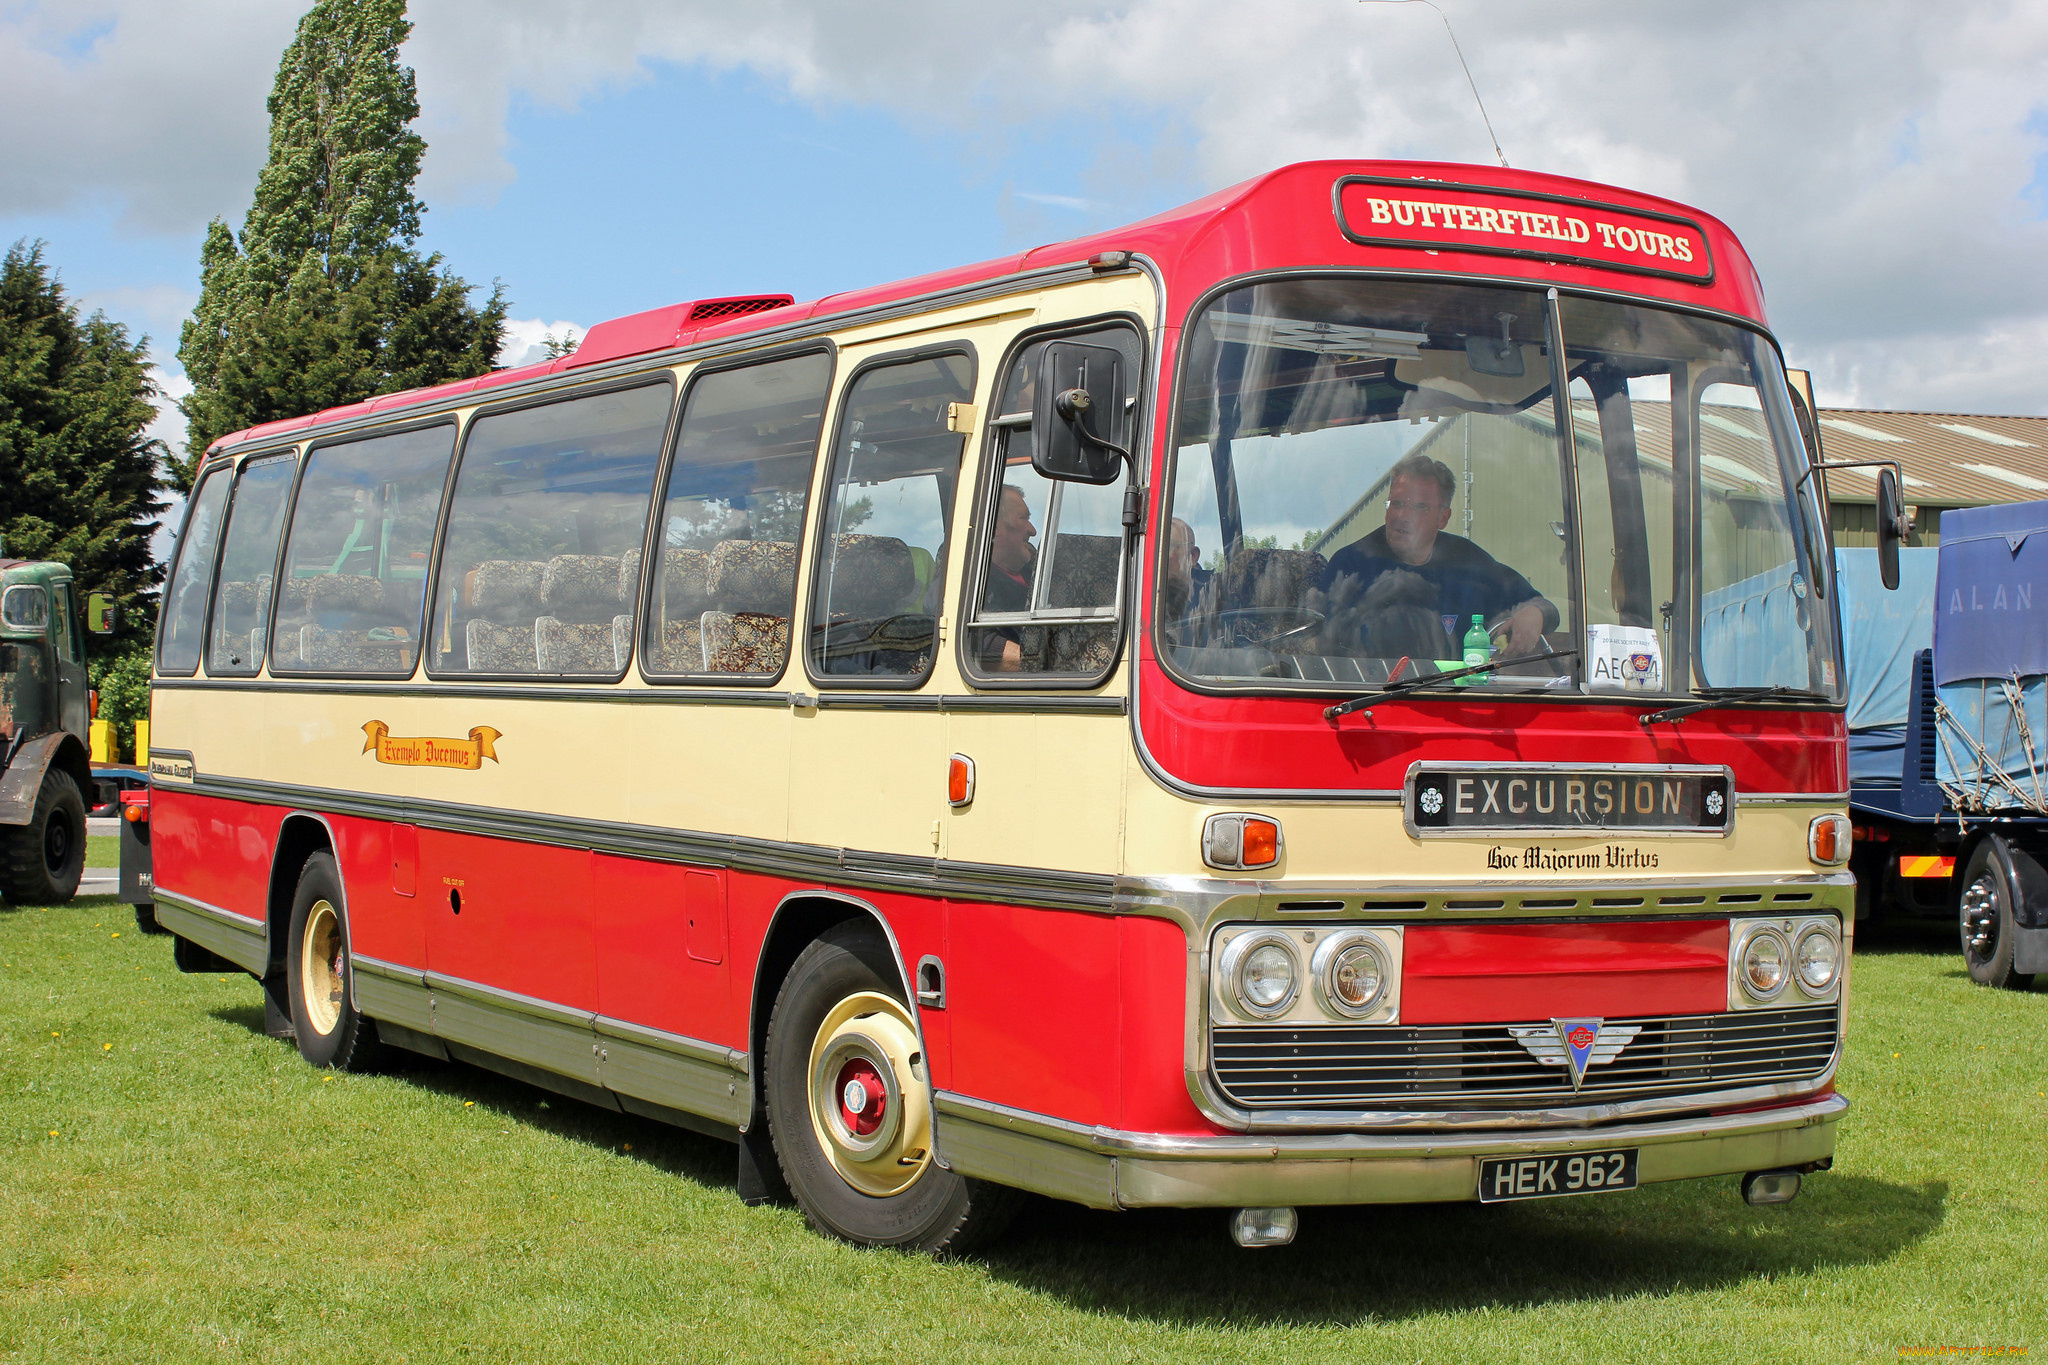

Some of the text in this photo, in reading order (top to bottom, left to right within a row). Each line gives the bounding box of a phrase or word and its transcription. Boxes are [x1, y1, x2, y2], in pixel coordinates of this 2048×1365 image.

[1366, 197, 1694, 264] BUTTERFIELD TOURS
[1949, 582, 2032, 615] ALAN
[1621, 639, 1639, 647] SOCIETY
[384, 739, 421, 764] Exemplo
[1454, 777, 1683, 815] EXCURSION
[1604, 845, 1659, 868] Virtus
[1570, 1032, 1592, 1043] AEC
[1495, 1153, 1626, 1196] HEK 962
